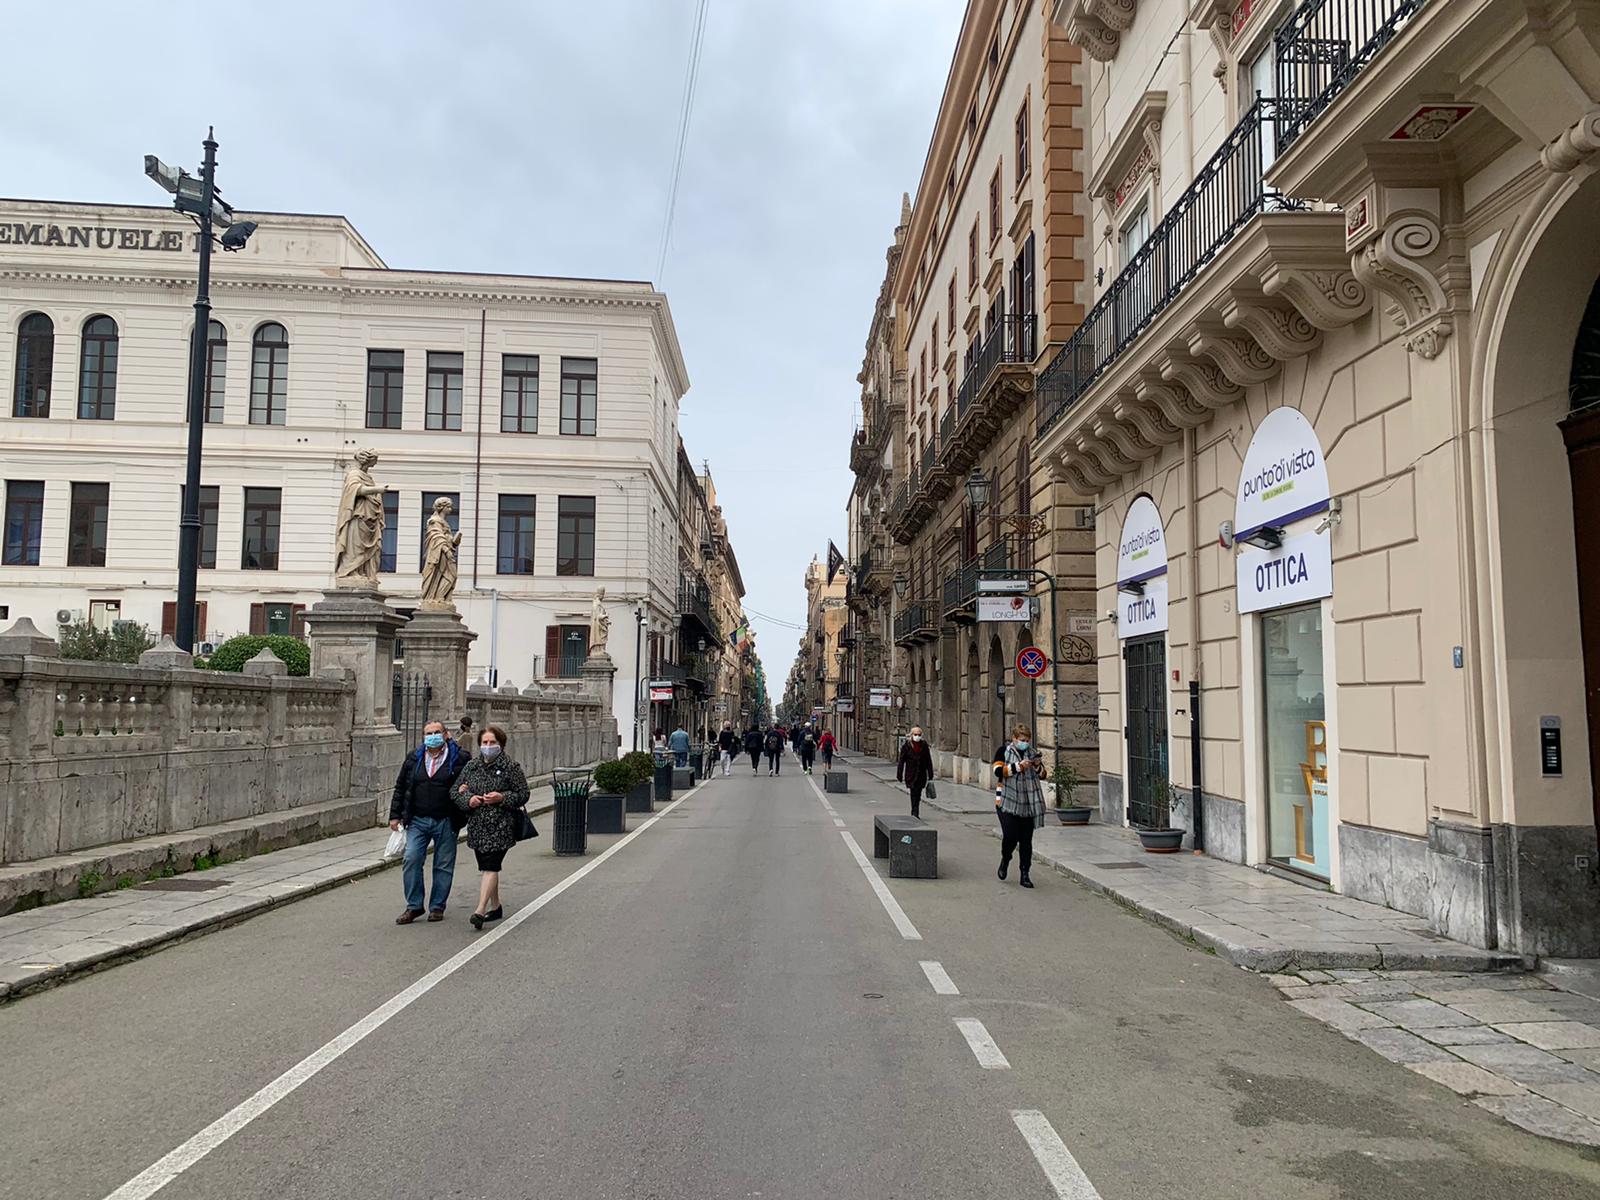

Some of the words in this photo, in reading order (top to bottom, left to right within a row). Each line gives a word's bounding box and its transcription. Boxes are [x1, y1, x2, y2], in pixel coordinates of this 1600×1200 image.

[0, 223, 182, 252] EMANUELE
[1286, 448, 1315, 477] vista
[1256, 552, 1308, 592] OTTICA
[1127, 597, 1156, 624] OTTICA
